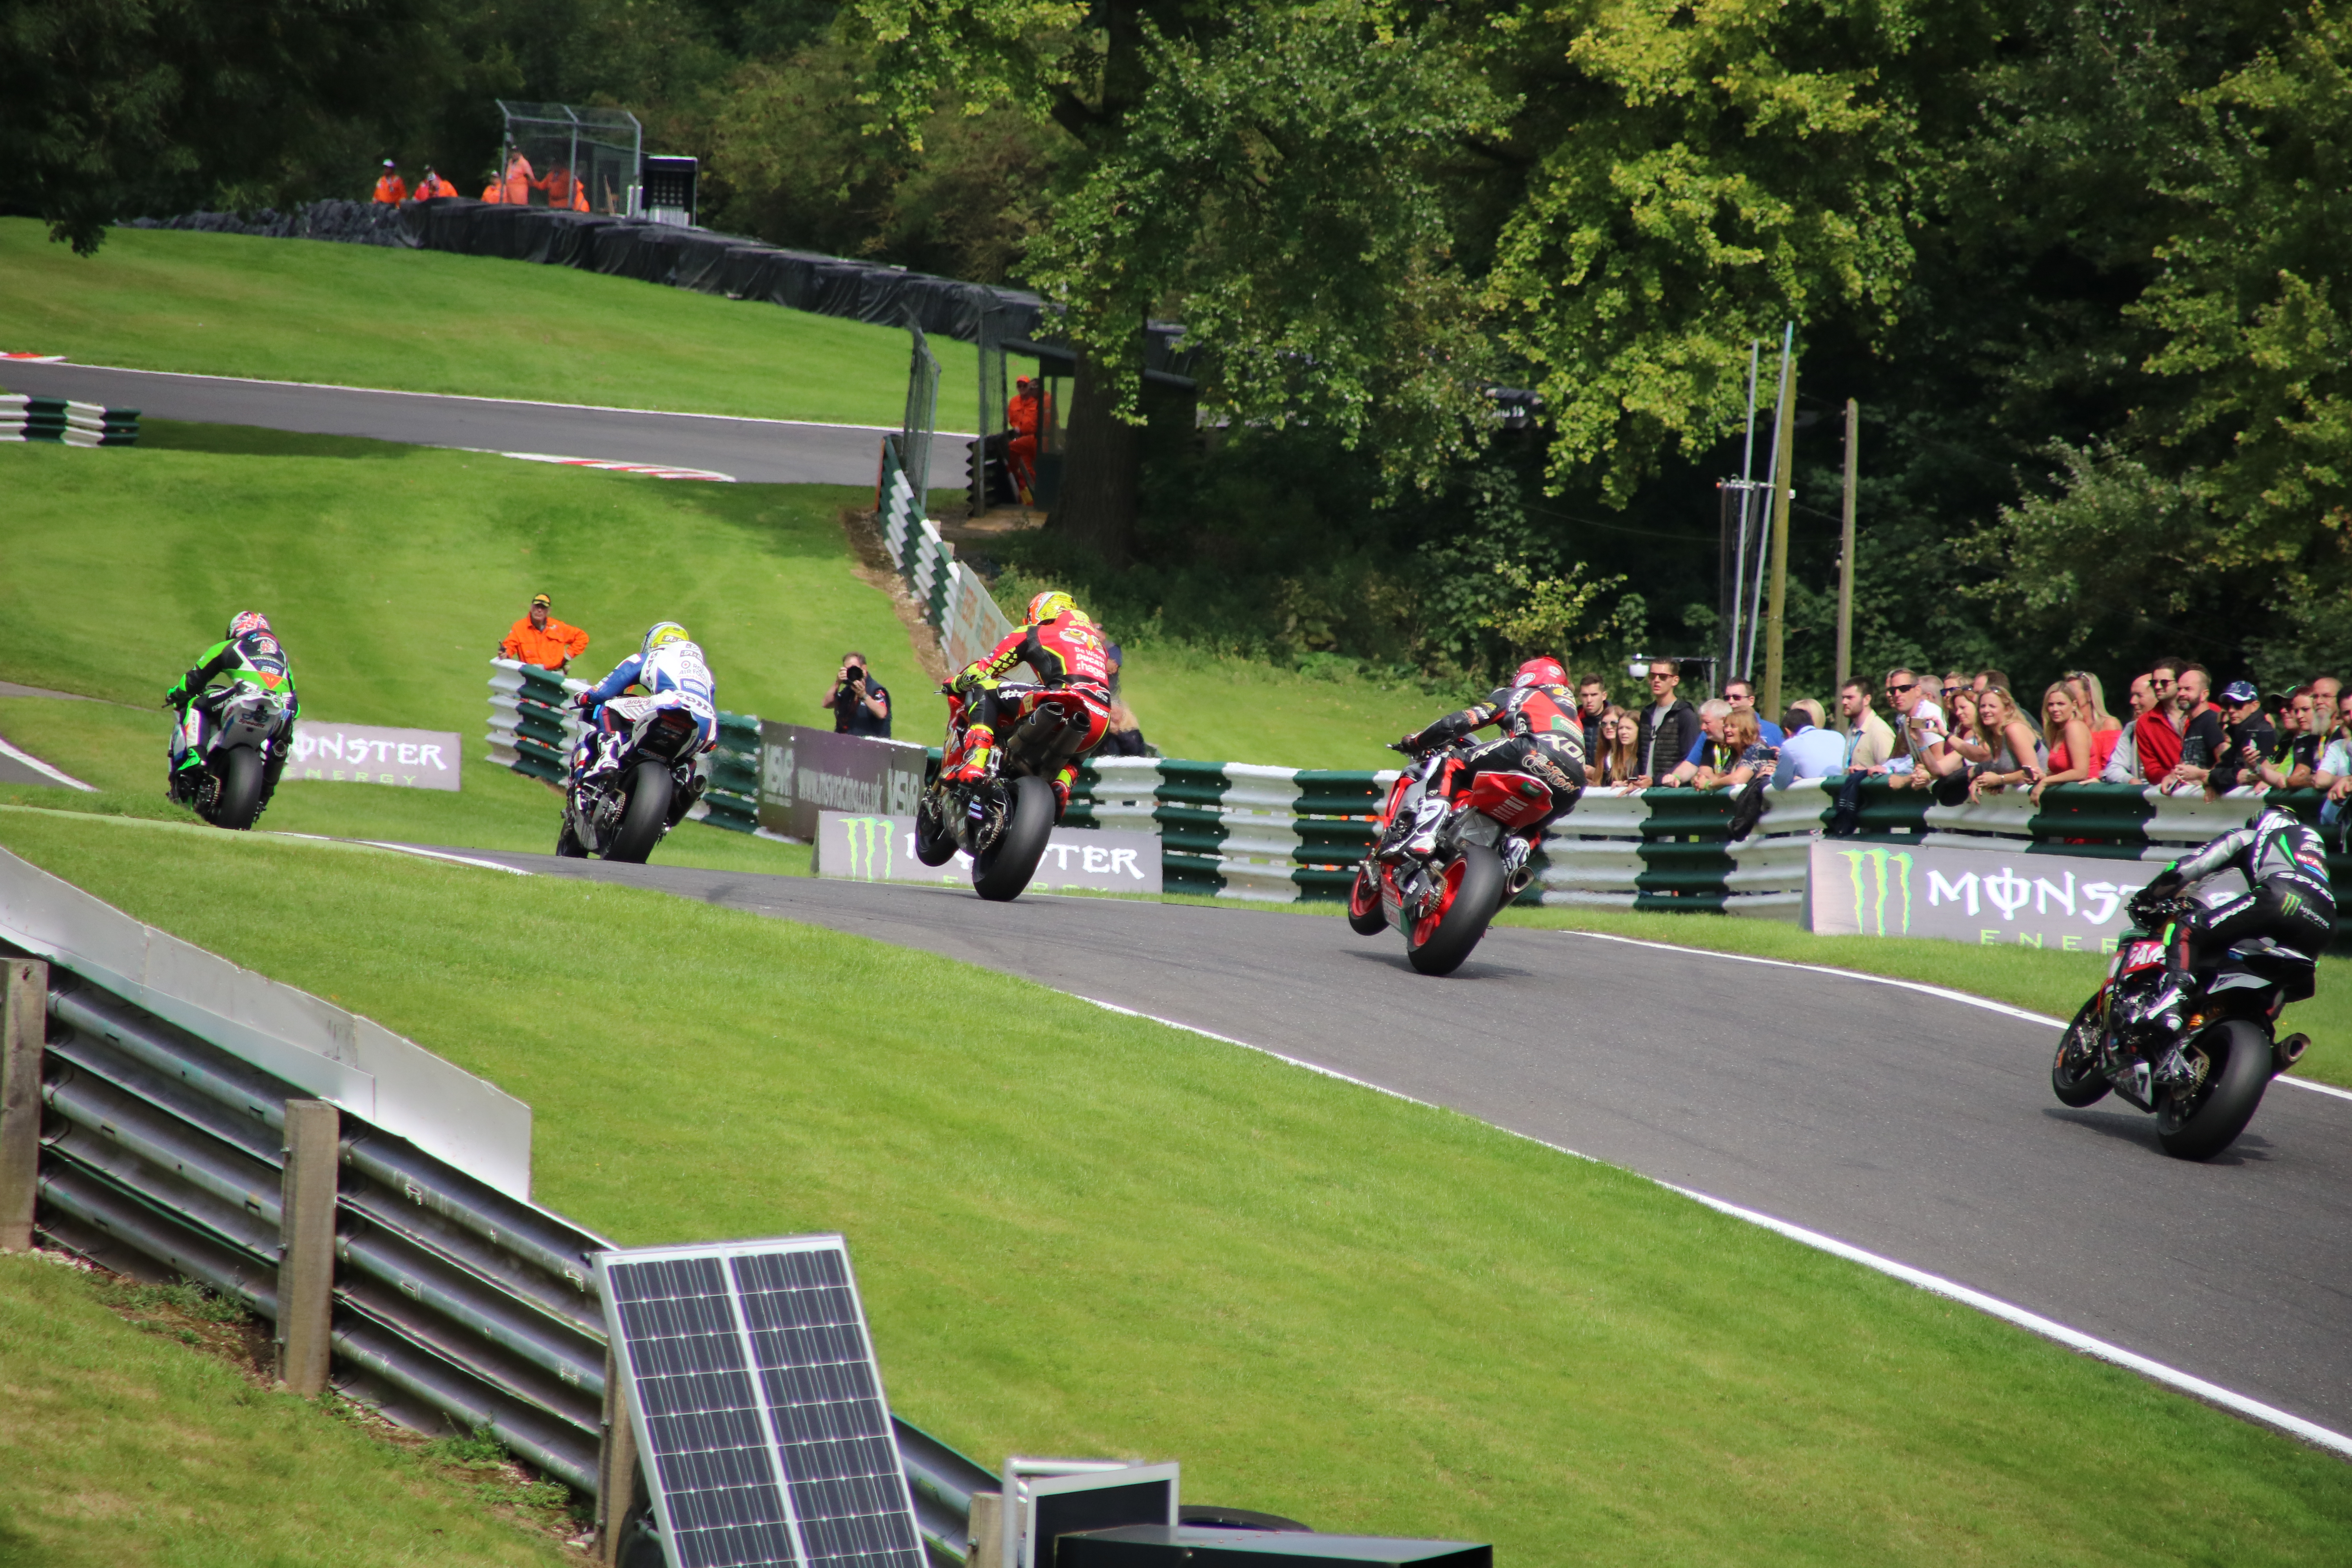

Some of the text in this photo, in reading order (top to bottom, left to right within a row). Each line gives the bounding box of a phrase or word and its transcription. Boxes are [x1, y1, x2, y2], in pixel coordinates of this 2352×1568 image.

[239, 718, 265, 728] Speedfit
[285, 729, 447, 771] ONSTER
[2209, 897, 2257, 929] SPIDI
[2299, 906, 2330, 929] MONSTER
[2138, 1073, 2149, 1094] 7
